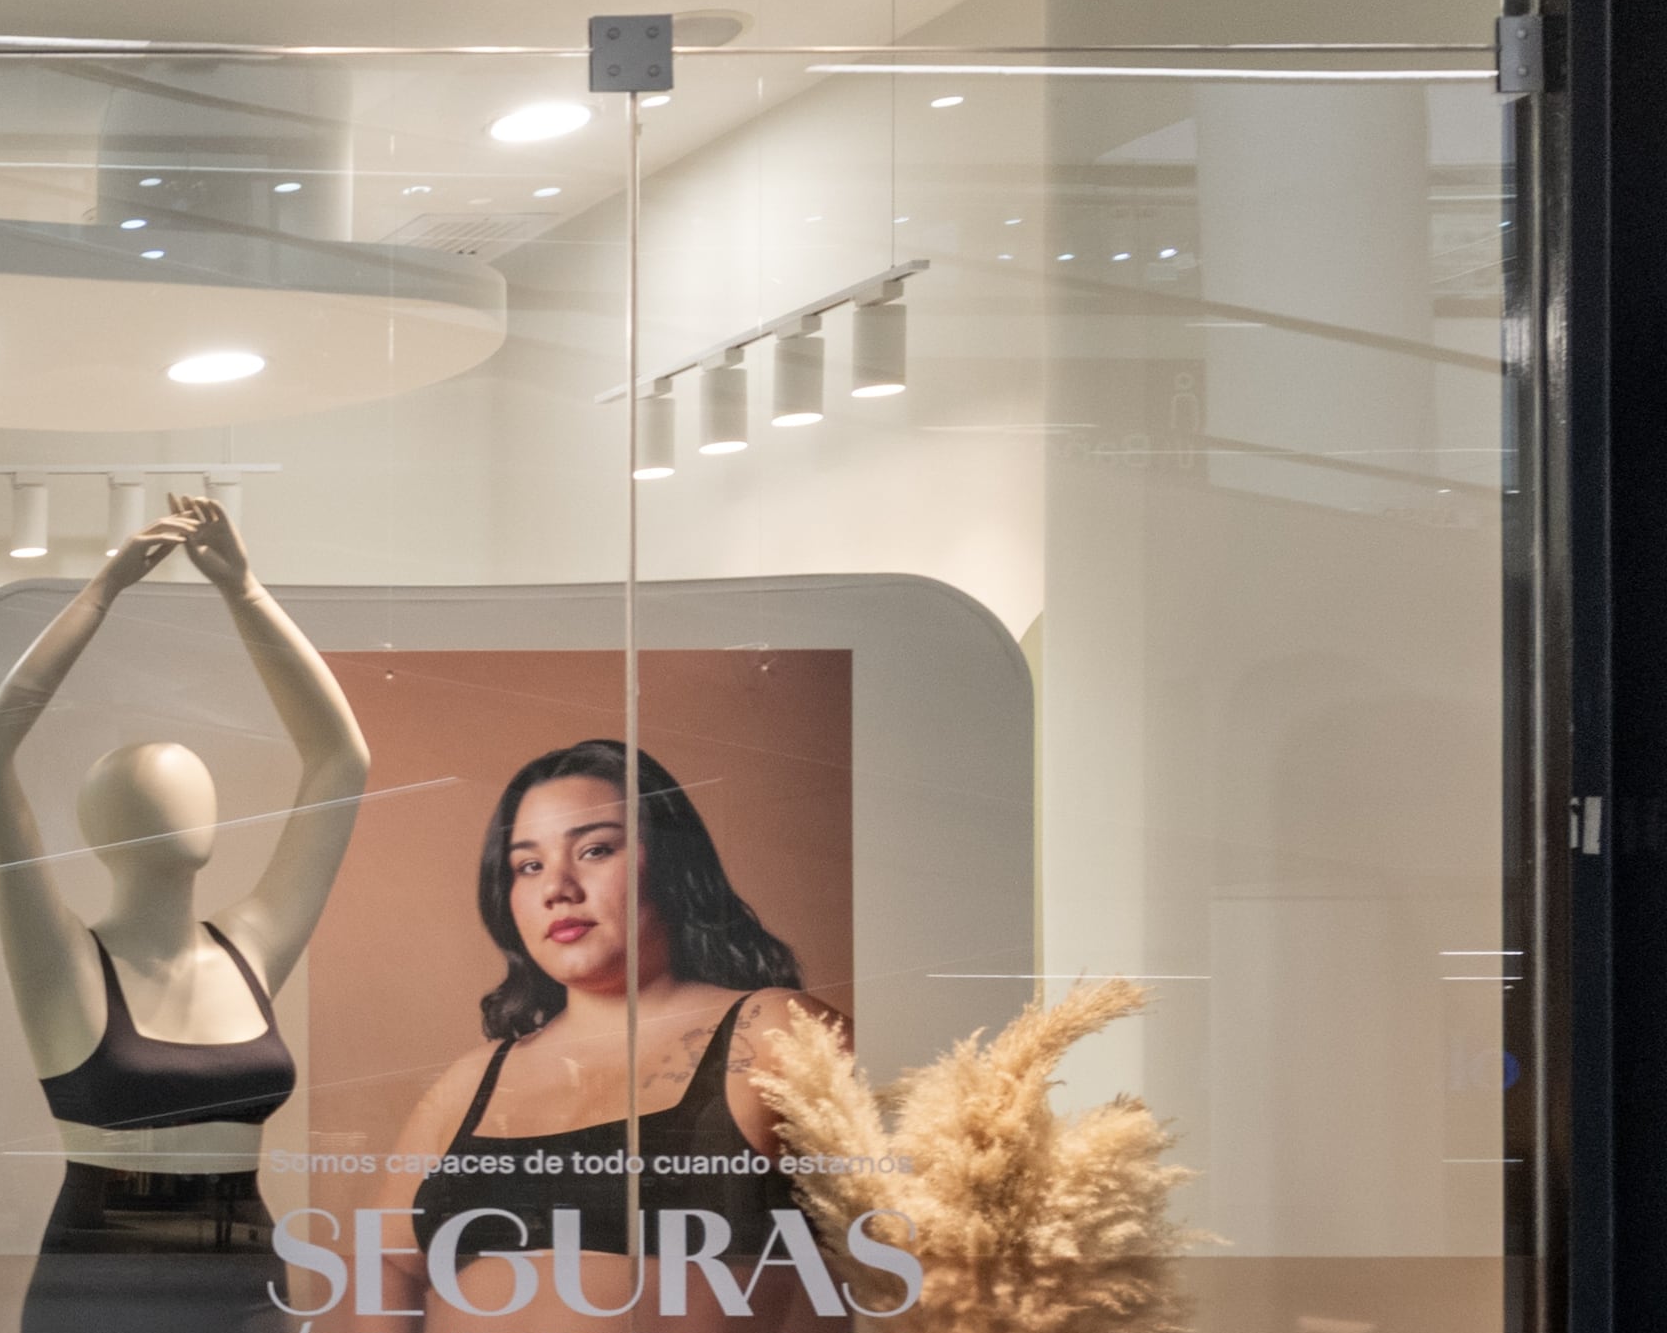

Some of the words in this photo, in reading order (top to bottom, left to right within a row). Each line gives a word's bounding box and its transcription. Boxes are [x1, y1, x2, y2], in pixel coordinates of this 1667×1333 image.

[269, 1149, 377, 1175] Somos
[385, 1152, 515, 1182] capaces
[524, 1148, 563, 1175] de
[571, 1148, 644, 1175] todo
[655, 1149, 770, 1175] cuando
[779, 1152, 914, 1176] estamos
[268, 1208, 924, 1318] SEGURAS
